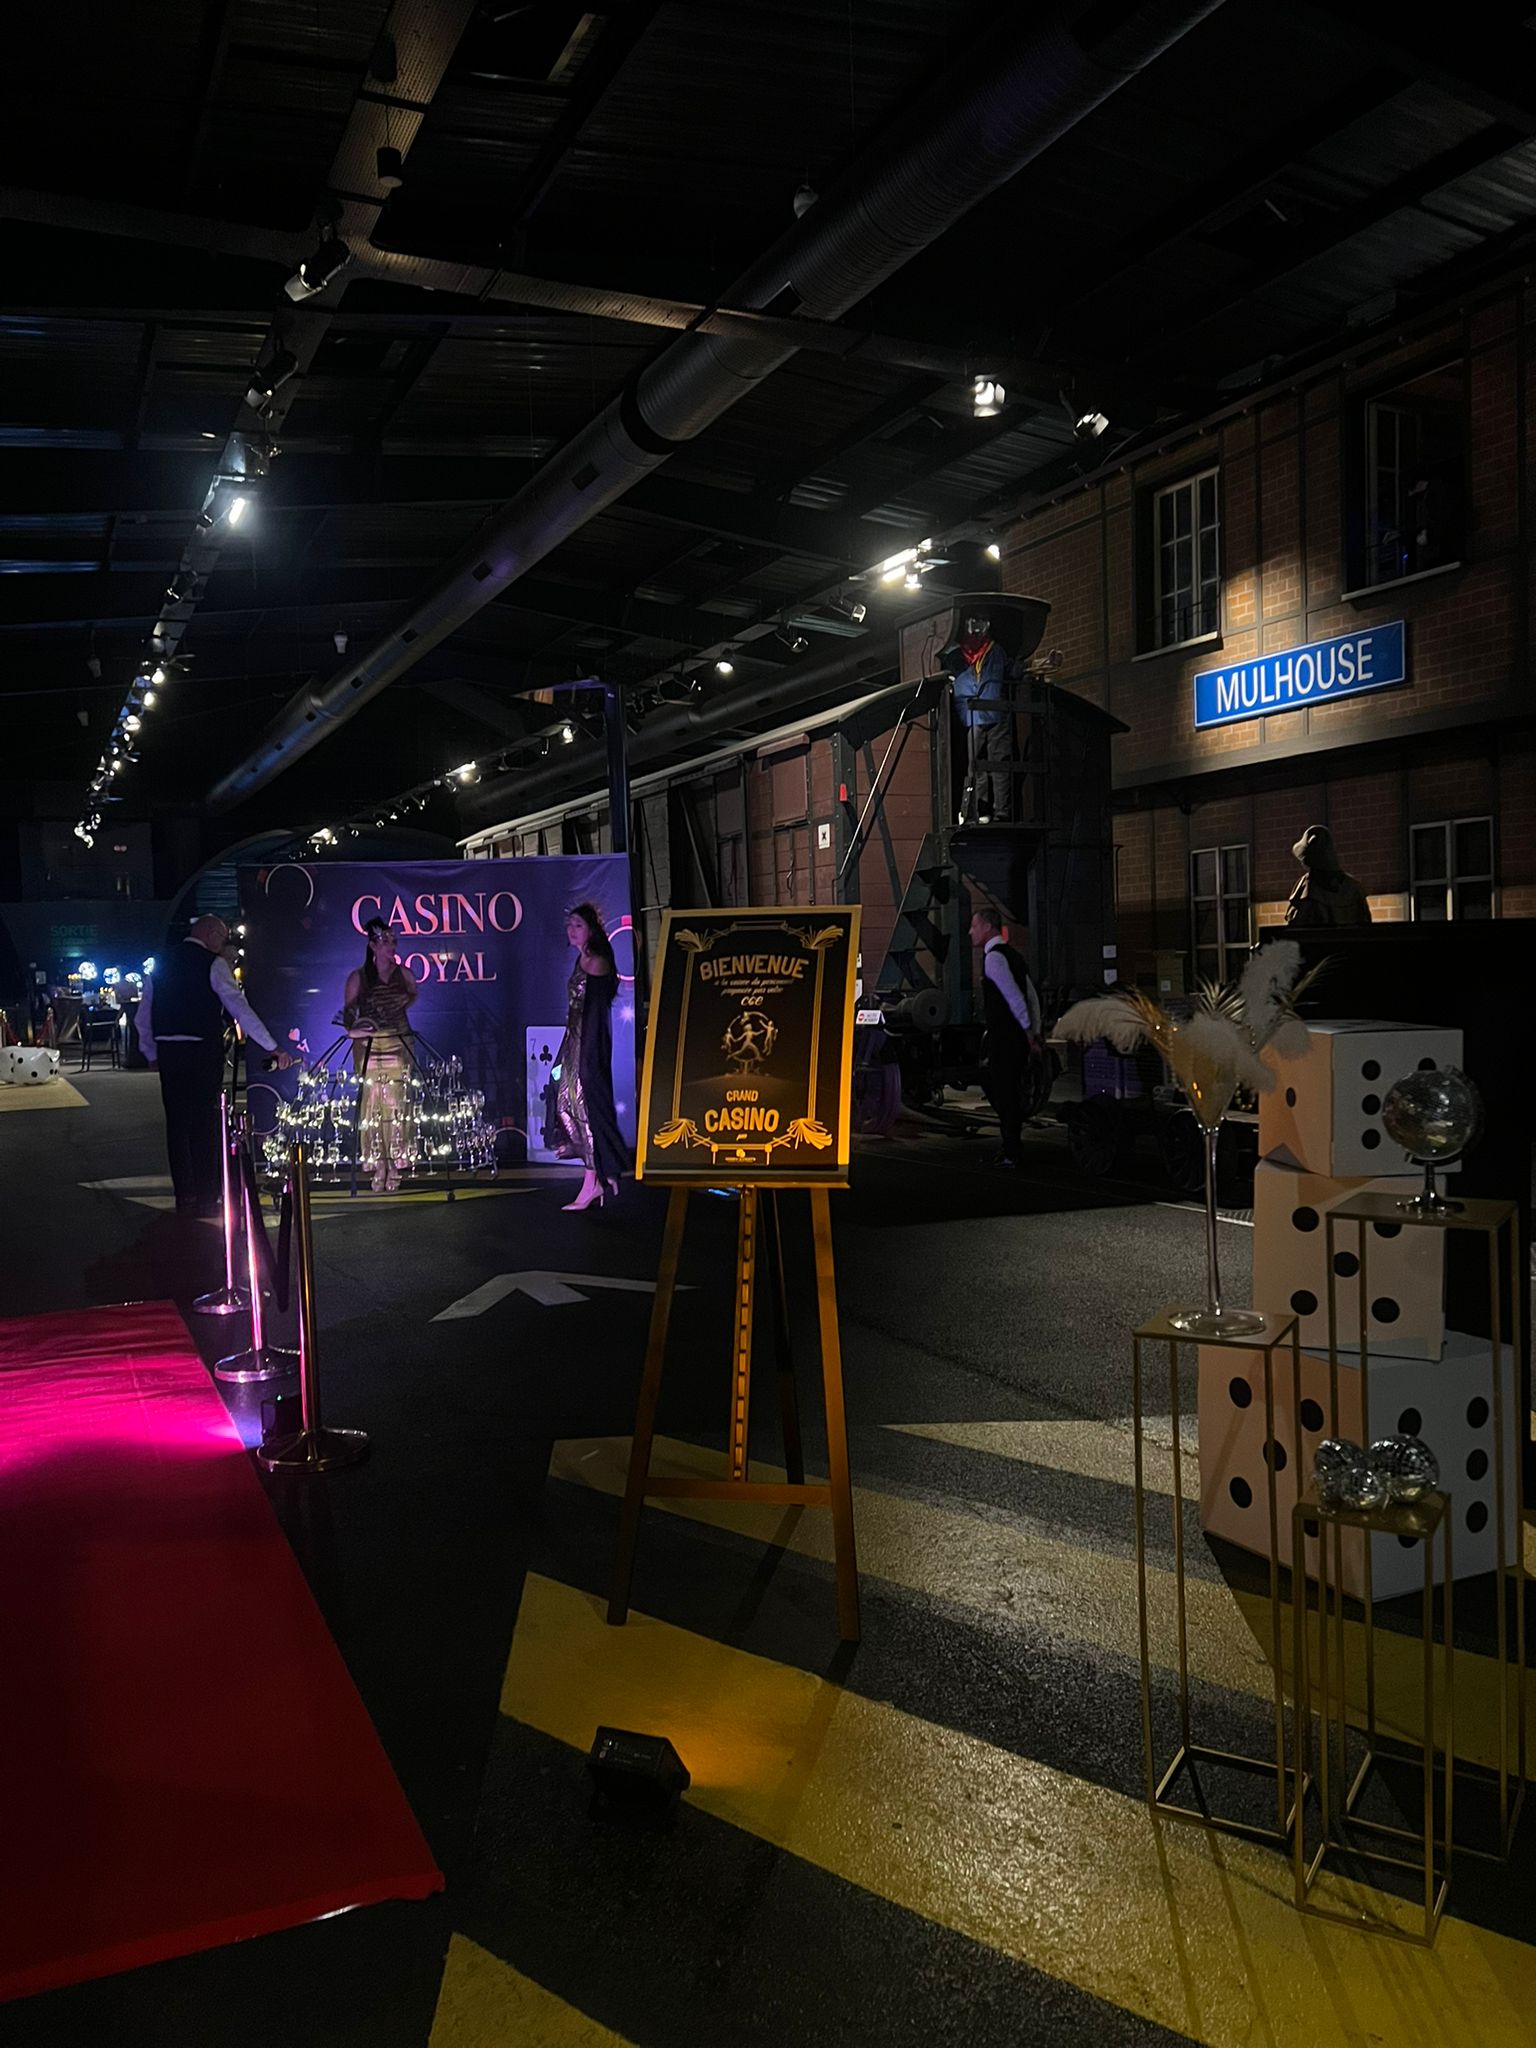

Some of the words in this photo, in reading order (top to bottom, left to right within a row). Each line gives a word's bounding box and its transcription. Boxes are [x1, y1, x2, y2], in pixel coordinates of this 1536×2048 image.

[1216, 637, 1374, 714] MULHOUSE
[350, 891, 524, 937] CASINO
[50, 924, 98, 937] SORTIE
[393, 951, 497, 984] OYAL
[699, 953, 810, 981] BIENVENUE
[726, 1089, 759, 1102] GRAND
[704, 1106, 780, 1133] CASINO
